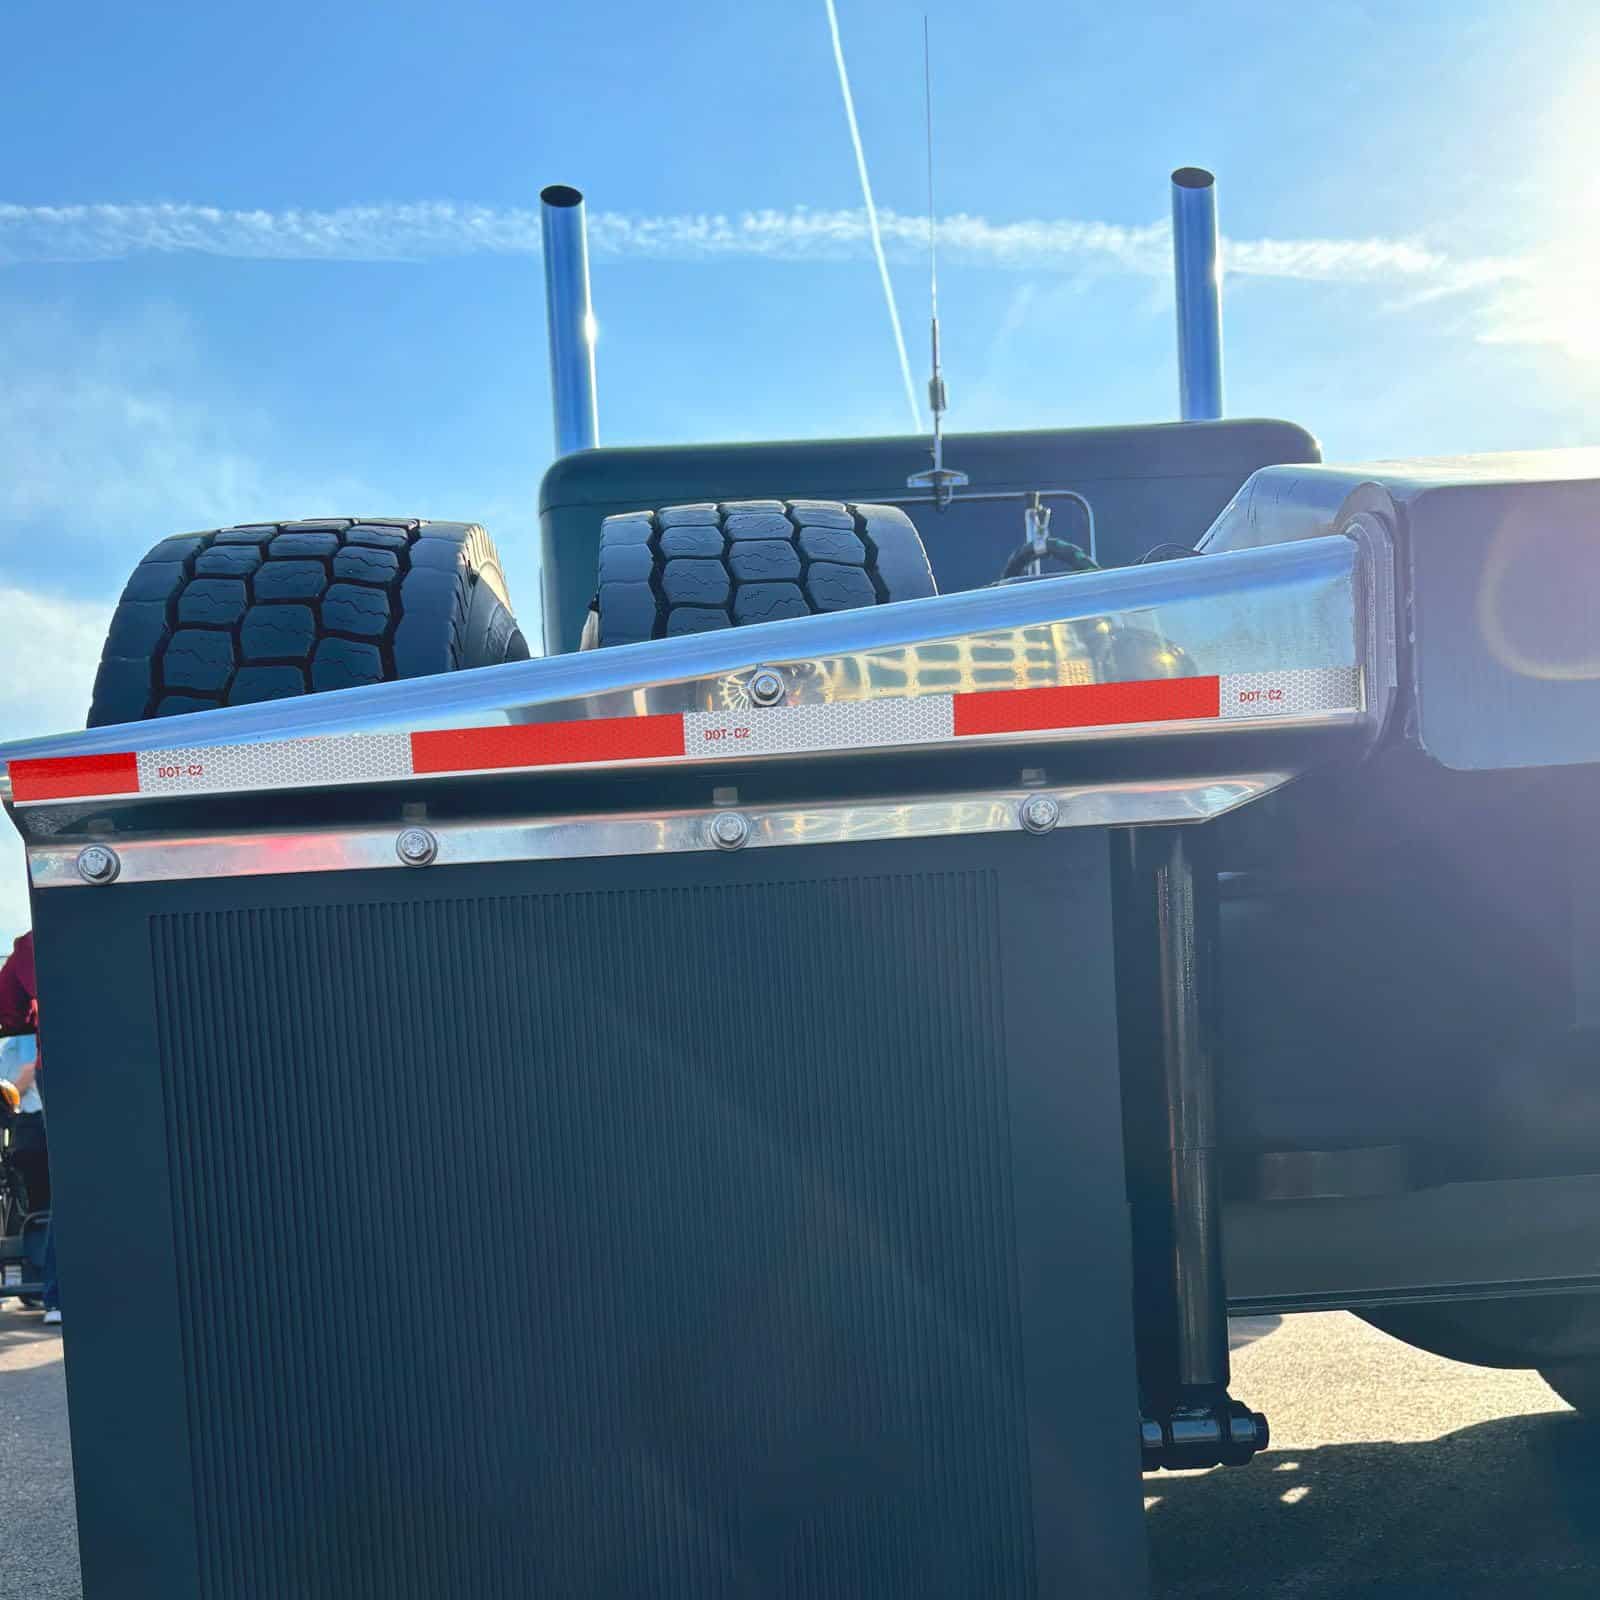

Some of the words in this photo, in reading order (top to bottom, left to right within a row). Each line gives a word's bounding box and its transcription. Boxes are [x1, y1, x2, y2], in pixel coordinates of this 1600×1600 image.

[1239, 690, 1282, 703] DOT-C2
[704, 728, 750, 741] DOT-C2
[158, 765, 203, 778] DOT-C2
